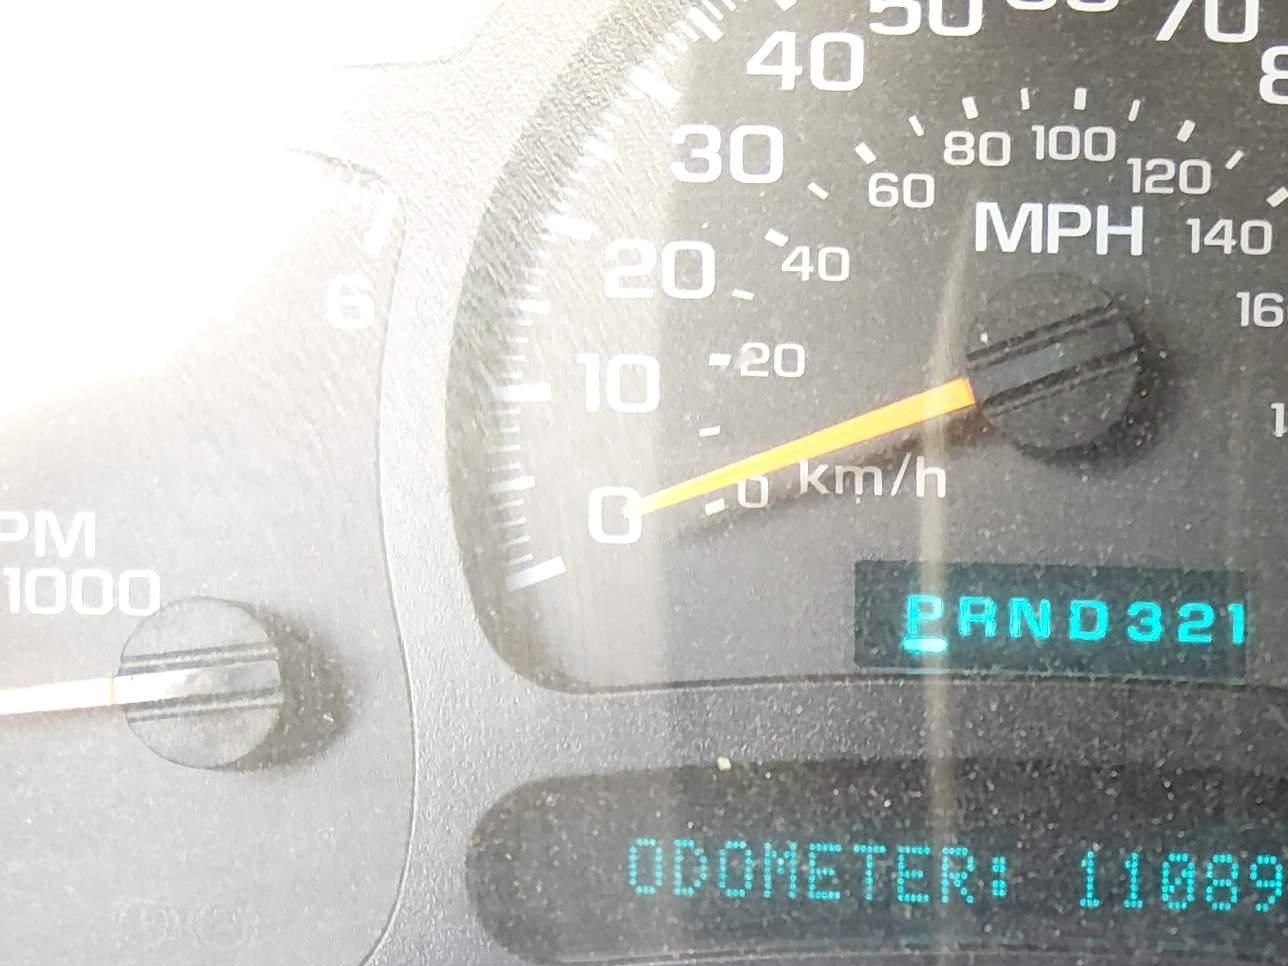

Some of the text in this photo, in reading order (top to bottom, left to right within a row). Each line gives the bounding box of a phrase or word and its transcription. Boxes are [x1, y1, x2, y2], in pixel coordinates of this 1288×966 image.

[869, 0, 983, 36] 50
[746, 30, 864, 91] 40
[671, 124, 784, 184] 30
[943, 131, 1010, 167] 80
[1031, 125, 1116, 161] 100
[868, 173, 934, 208] 60
[1127, 158, 1211, 194] 120
[975, 202, 1143, 256] MPH
[1186, 218, 1272, 255] 140
[604, 240, 716, 299] 20
[781, 245, 850, 282] 40
[326, 273, 376, 331] 6
[577, 353, 661, 413] 10
[740, 342, 805, 378] 20
[737, 474, 768, 508] 0
[799, 454, 947, 498] km/h
[0, 510, 96, 558] PM
[588, 486, 642, 545] 0
[3, 567, 161, 616] 1000
[627, 837, 1008, 905] ODOMETER:
